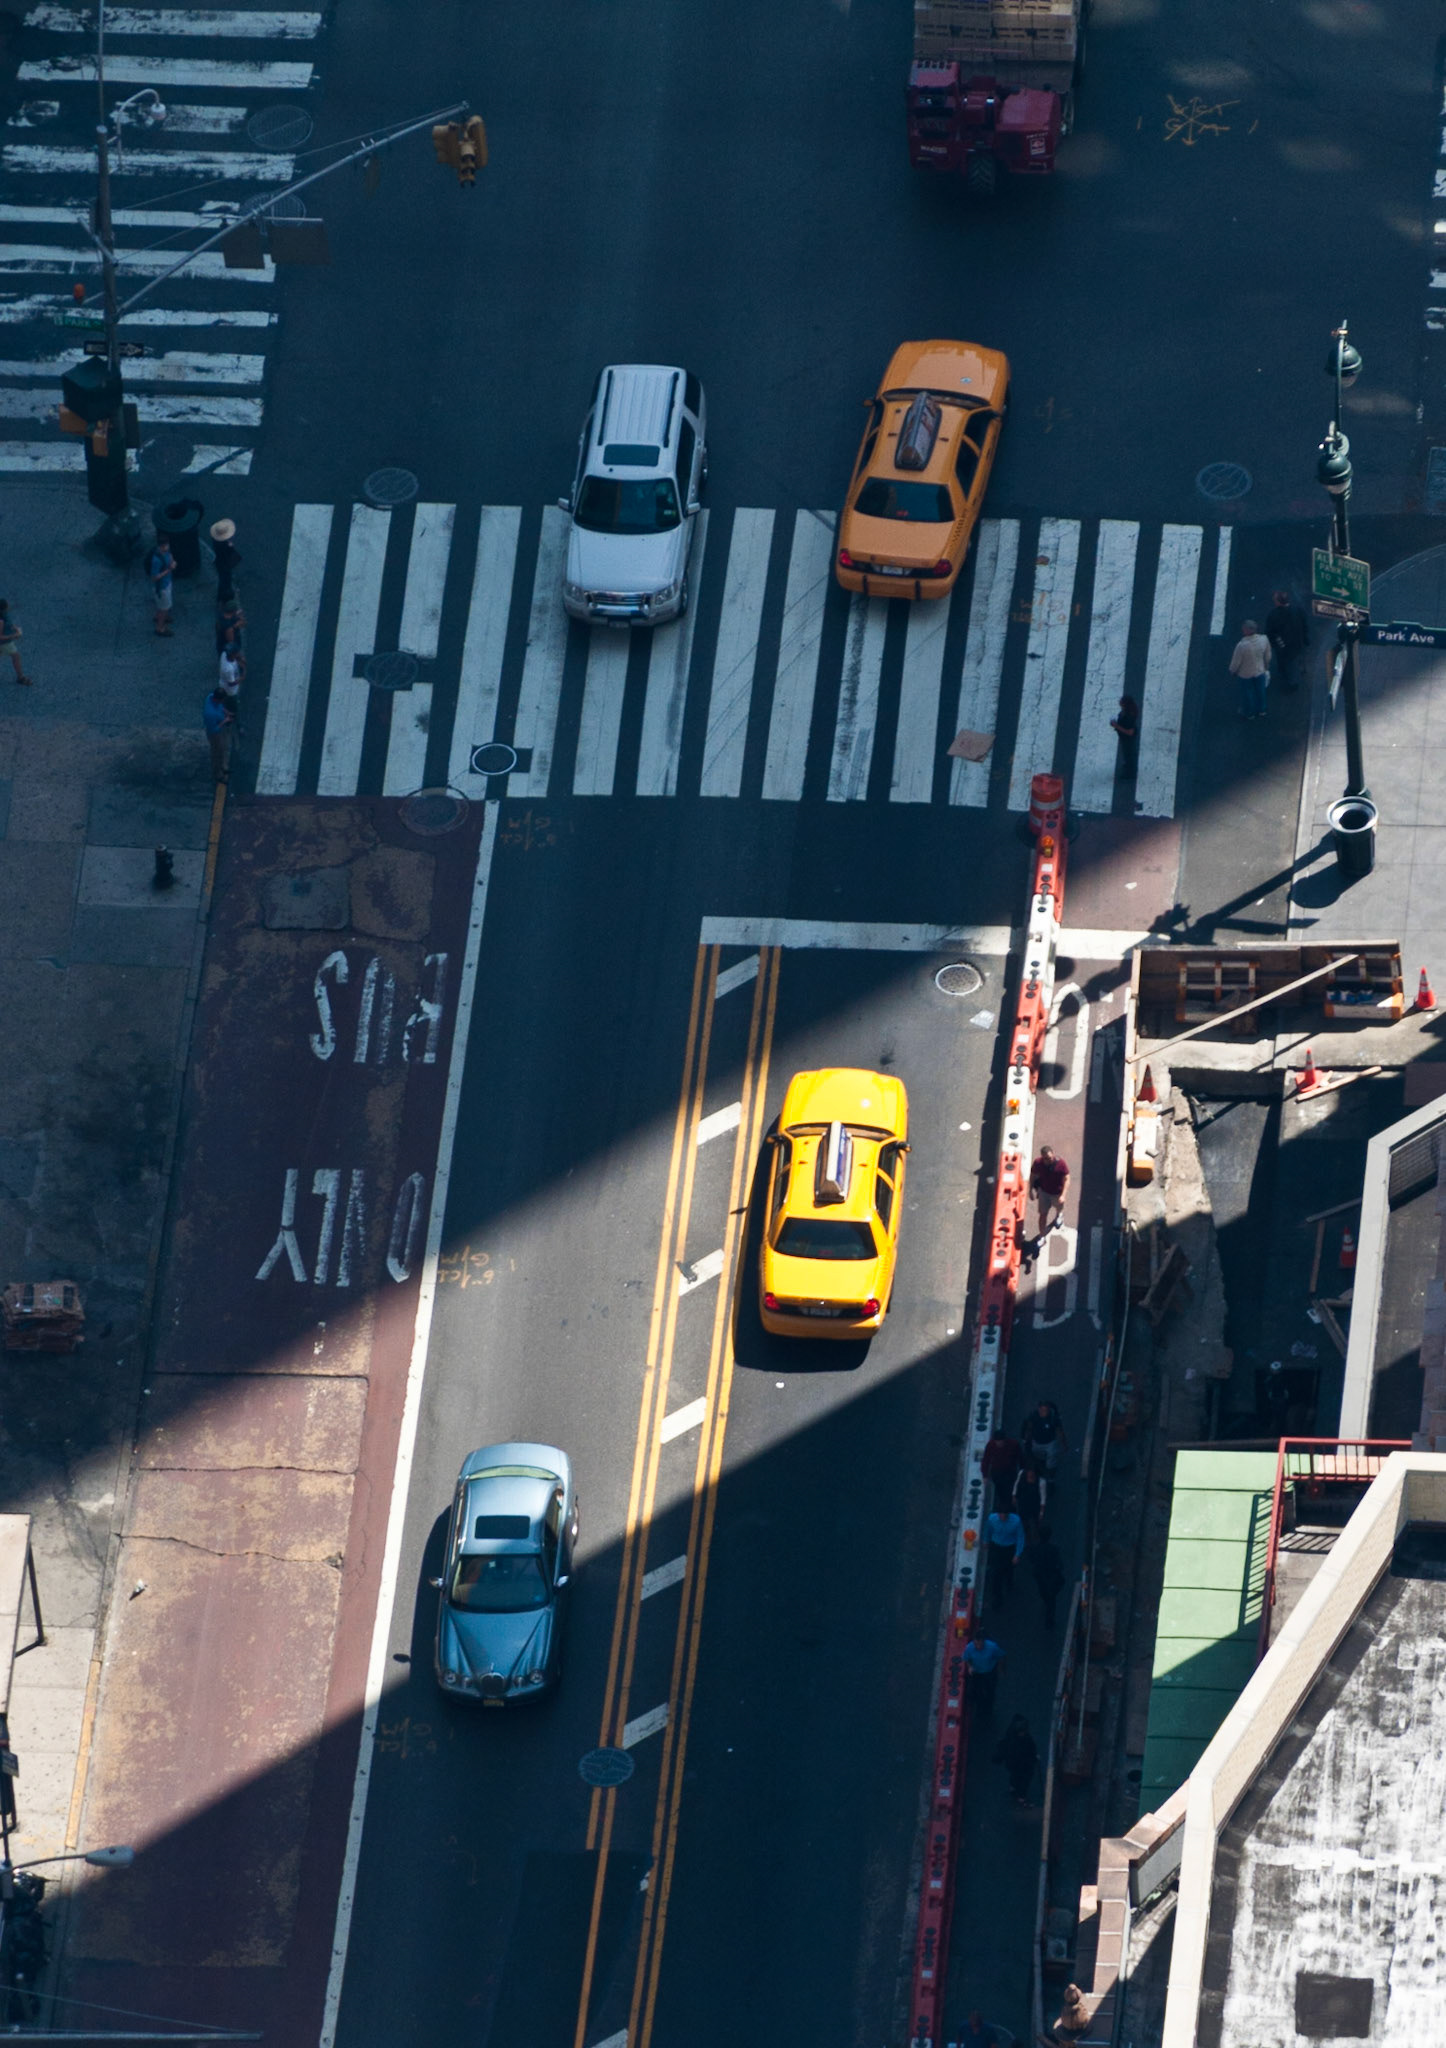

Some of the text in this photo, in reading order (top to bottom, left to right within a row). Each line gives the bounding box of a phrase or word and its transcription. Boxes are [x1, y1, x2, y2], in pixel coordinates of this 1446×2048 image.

[1378, 630, 1436, 645] Park Ave
[309, 950, 449, 1064] BUS
[255, 1168, 426, 1287] ONLY
